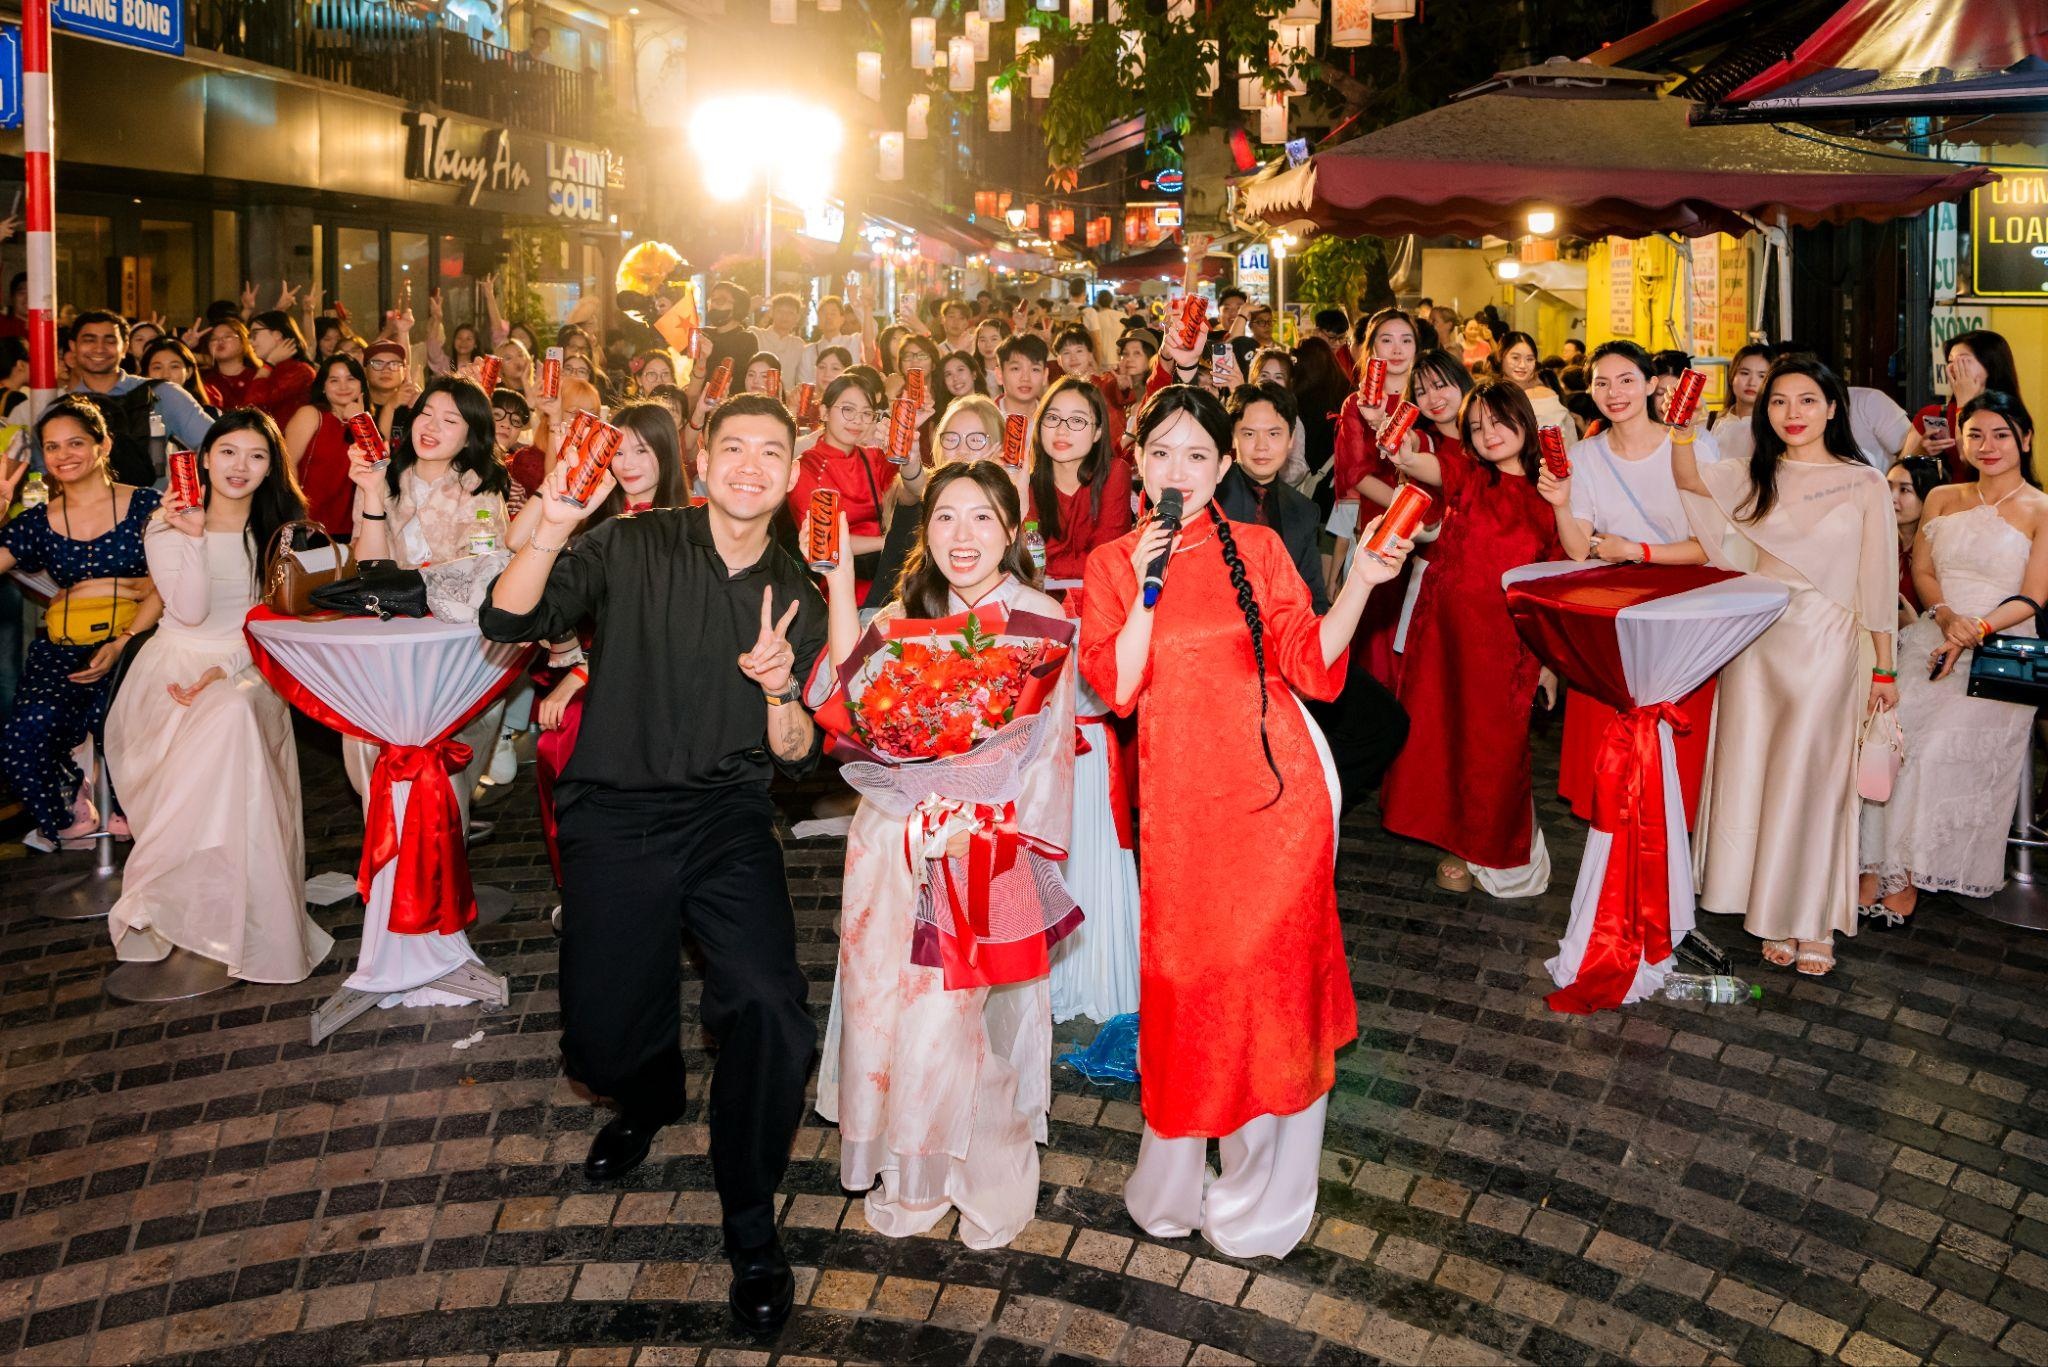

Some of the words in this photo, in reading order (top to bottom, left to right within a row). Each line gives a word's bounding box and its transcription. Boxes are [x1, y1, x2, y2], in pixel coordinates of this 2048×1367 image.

[547, 140, 606, 188] LATIN
[549, 180, 604, 222] SOUL
[1989, 216, 2048, 244] LOA
[812, 489, 832, 561] Coca-Cola
